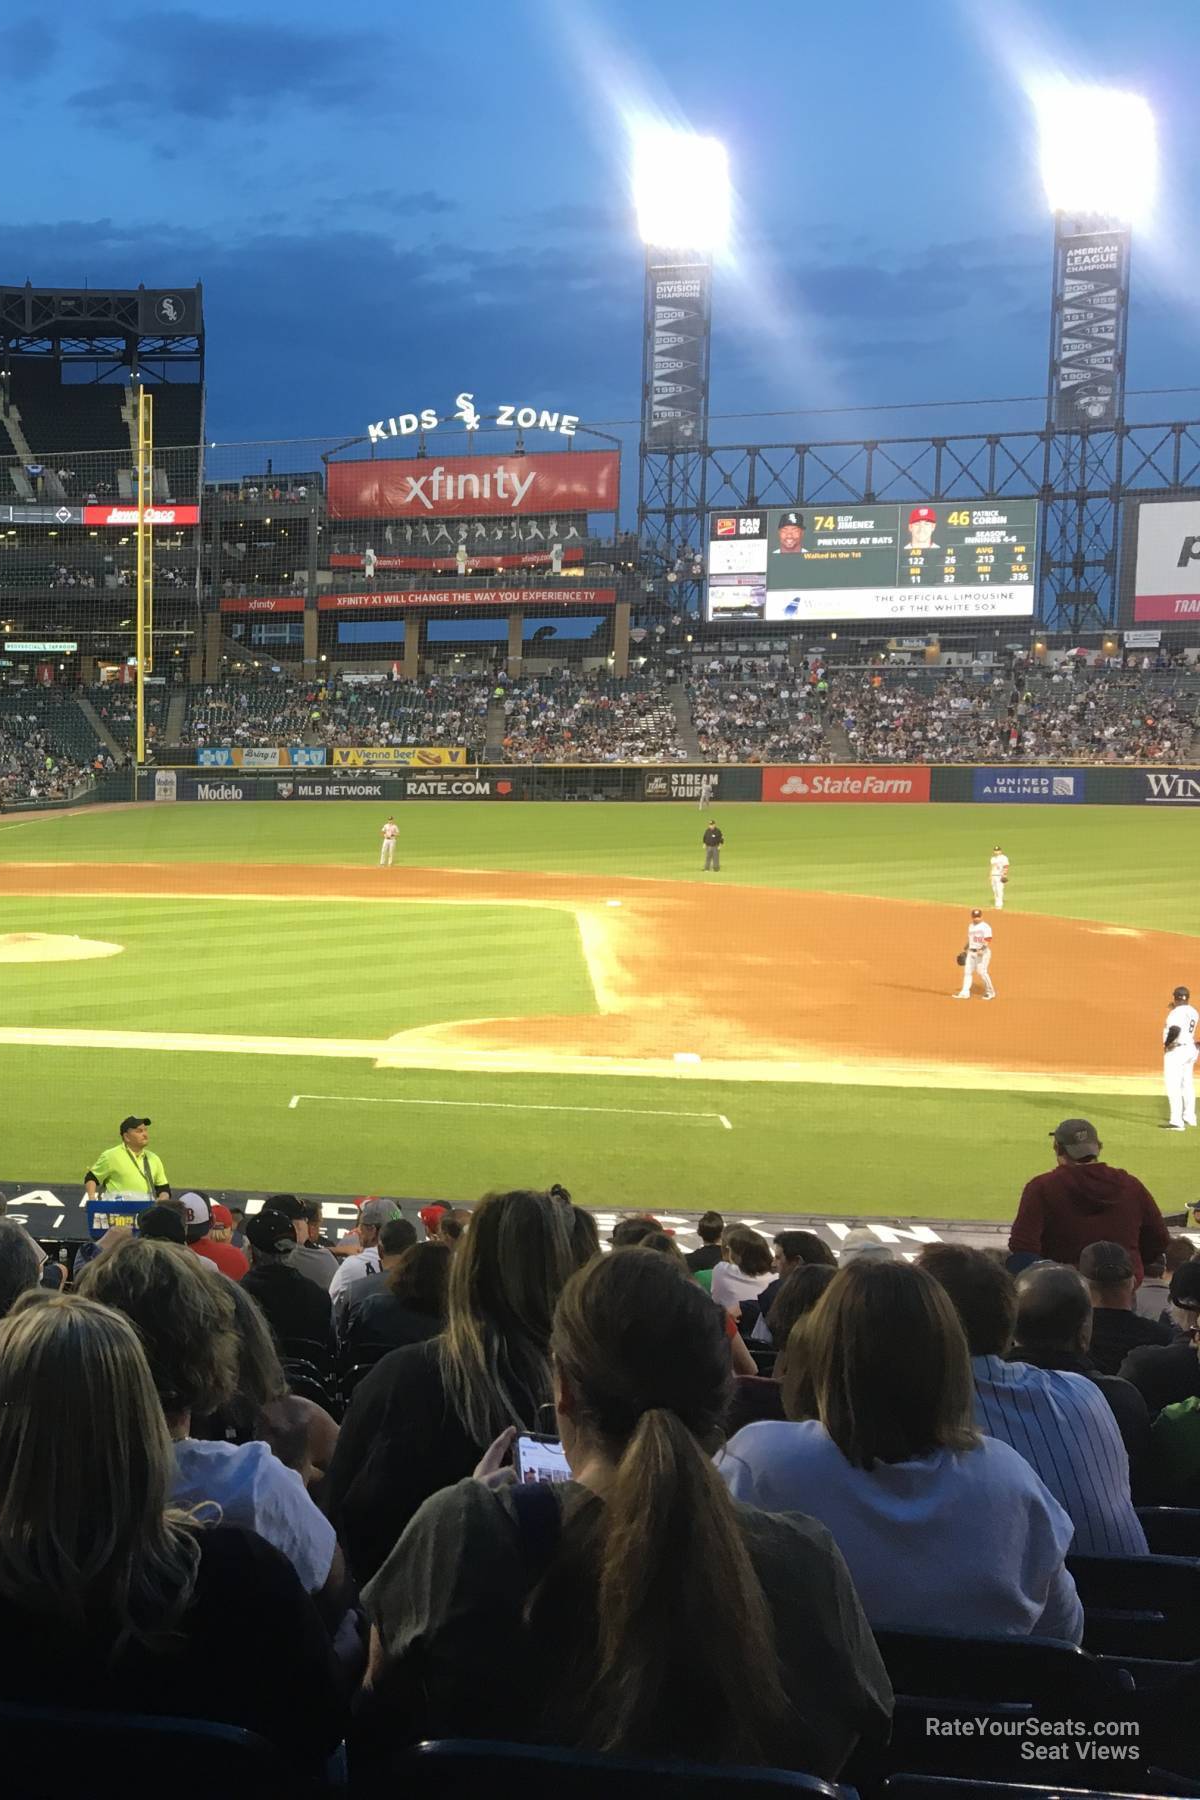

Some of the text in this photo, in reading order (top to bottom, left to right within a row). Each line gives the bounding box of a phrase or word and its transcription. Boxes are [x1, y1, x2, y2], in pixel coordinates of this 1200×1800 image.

[1067, 246, 1118, 257] AMERICAN
[1067, 253, 1117, 266] LEAGUE
[1066, 263, 1117, 273] CHAMPIONS
[656, 285, 700, 293] DIVISION
[368, 409, 438, 443] KIDS
[496, 405, 579, 436] ZONE
[405, 465, 536, 510] xfinity
[740, 518, 761, 527] FAN
[948, 510, 999, 526] 46 PATRICK
[972, 516, 1007, 525] CORBIN
[814, 516, 835, 531] 74
[837, 521, 874, 530] JIMENEZ
[740, 526, 760, 534] BOX
[817, 537, 893, 546] PREVIOUS AT BATS
[965, 535, 1017, 544] INNINGS 4-6
[804, 552, 829, 560] Walked
[908, 557, 924, 565] 122
[945, 556, 956, 564] 26
[976, 555, 994, 563] .213
[911, 573, 1028, 584] 11 32 11 .336
[337, 597, 369, 606] XFINITY
[384, 595, 406, 604] WILL
[408, 593, 449, 603] CHANGE
[452, 593, 471, 602] THE
[474, 592, 497, 601] WAY
[499, 592, 520, 601] YOU
[522, 591, 581, 600] EXPERIENCE
[584, 591, 596, 600] TV
[899, 594, 949, 602] OFFICIAL
[953, 592, 1014, 601] LIMOUSINE
[249, 600, 275, 610] xfinity
[891, 603, 997, 613] OF THE WHITE SOX
[1174, 600, 1200, 613] TRA
[245, 748, 269, 760] Bring
[356, 749, 390, 759] Vienna
[394, 749, 416, 759] Beef
[671, 774, 719, 785] STREAM
[997, 778, 1049, 786] UNITED
[198, 784, 243, 800] Modelo
[299, 786, 381, 796] MLB NETWORK
[407, 782, 490, 795] RATE.COM
[983, 786, 1049, 794] AIRLINES
[1189, 1019, 1195, 1033] 8
